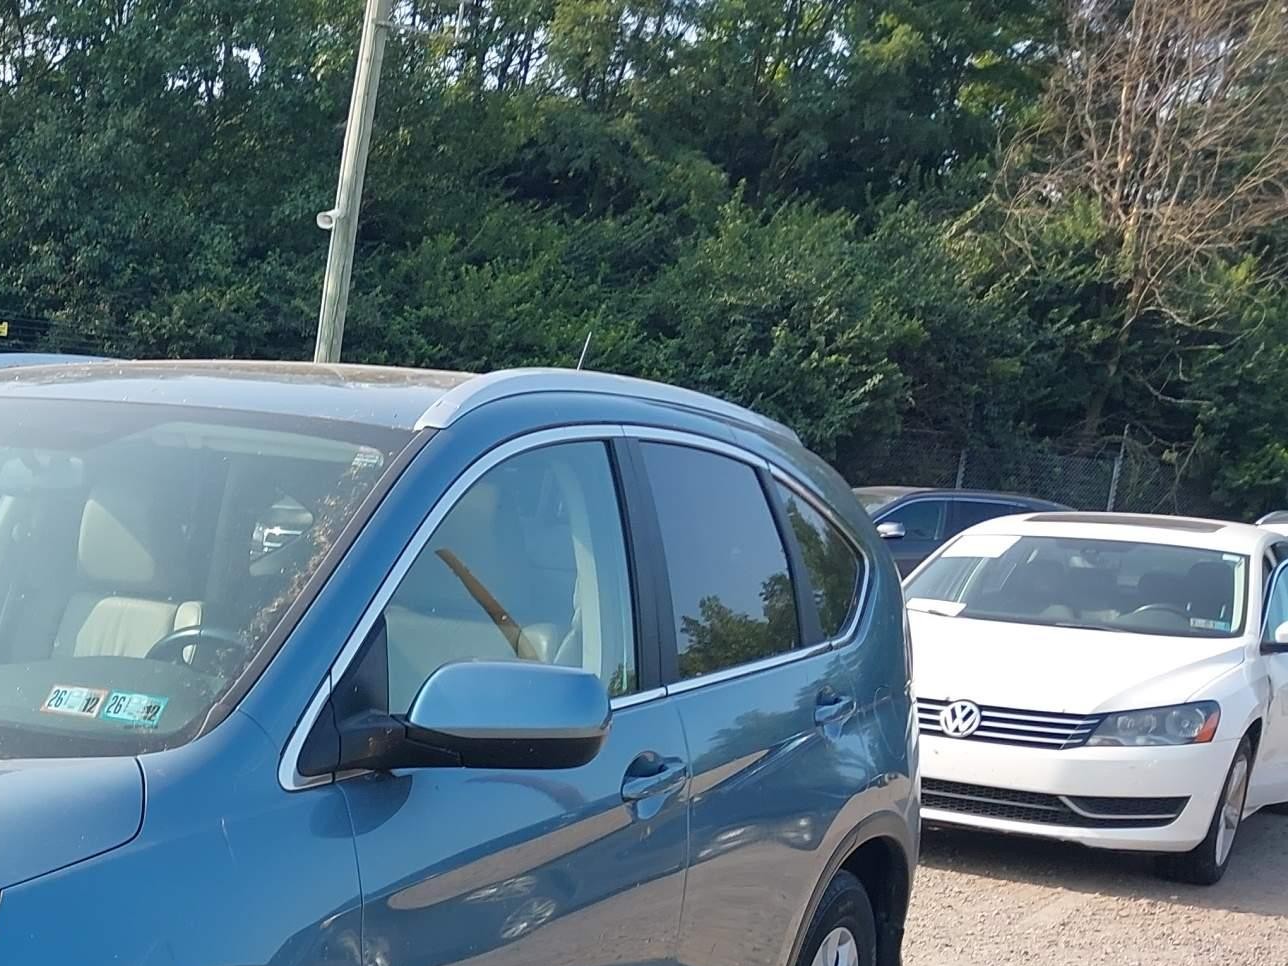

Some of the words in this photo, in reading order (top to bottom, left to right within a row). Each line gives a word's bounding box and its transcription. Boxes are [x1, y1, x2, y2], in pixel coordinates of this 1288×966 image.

[47, 689, 67, 708] 26
[81, 697, 100, 714] 12
[106, 695, 126, 715] 26
